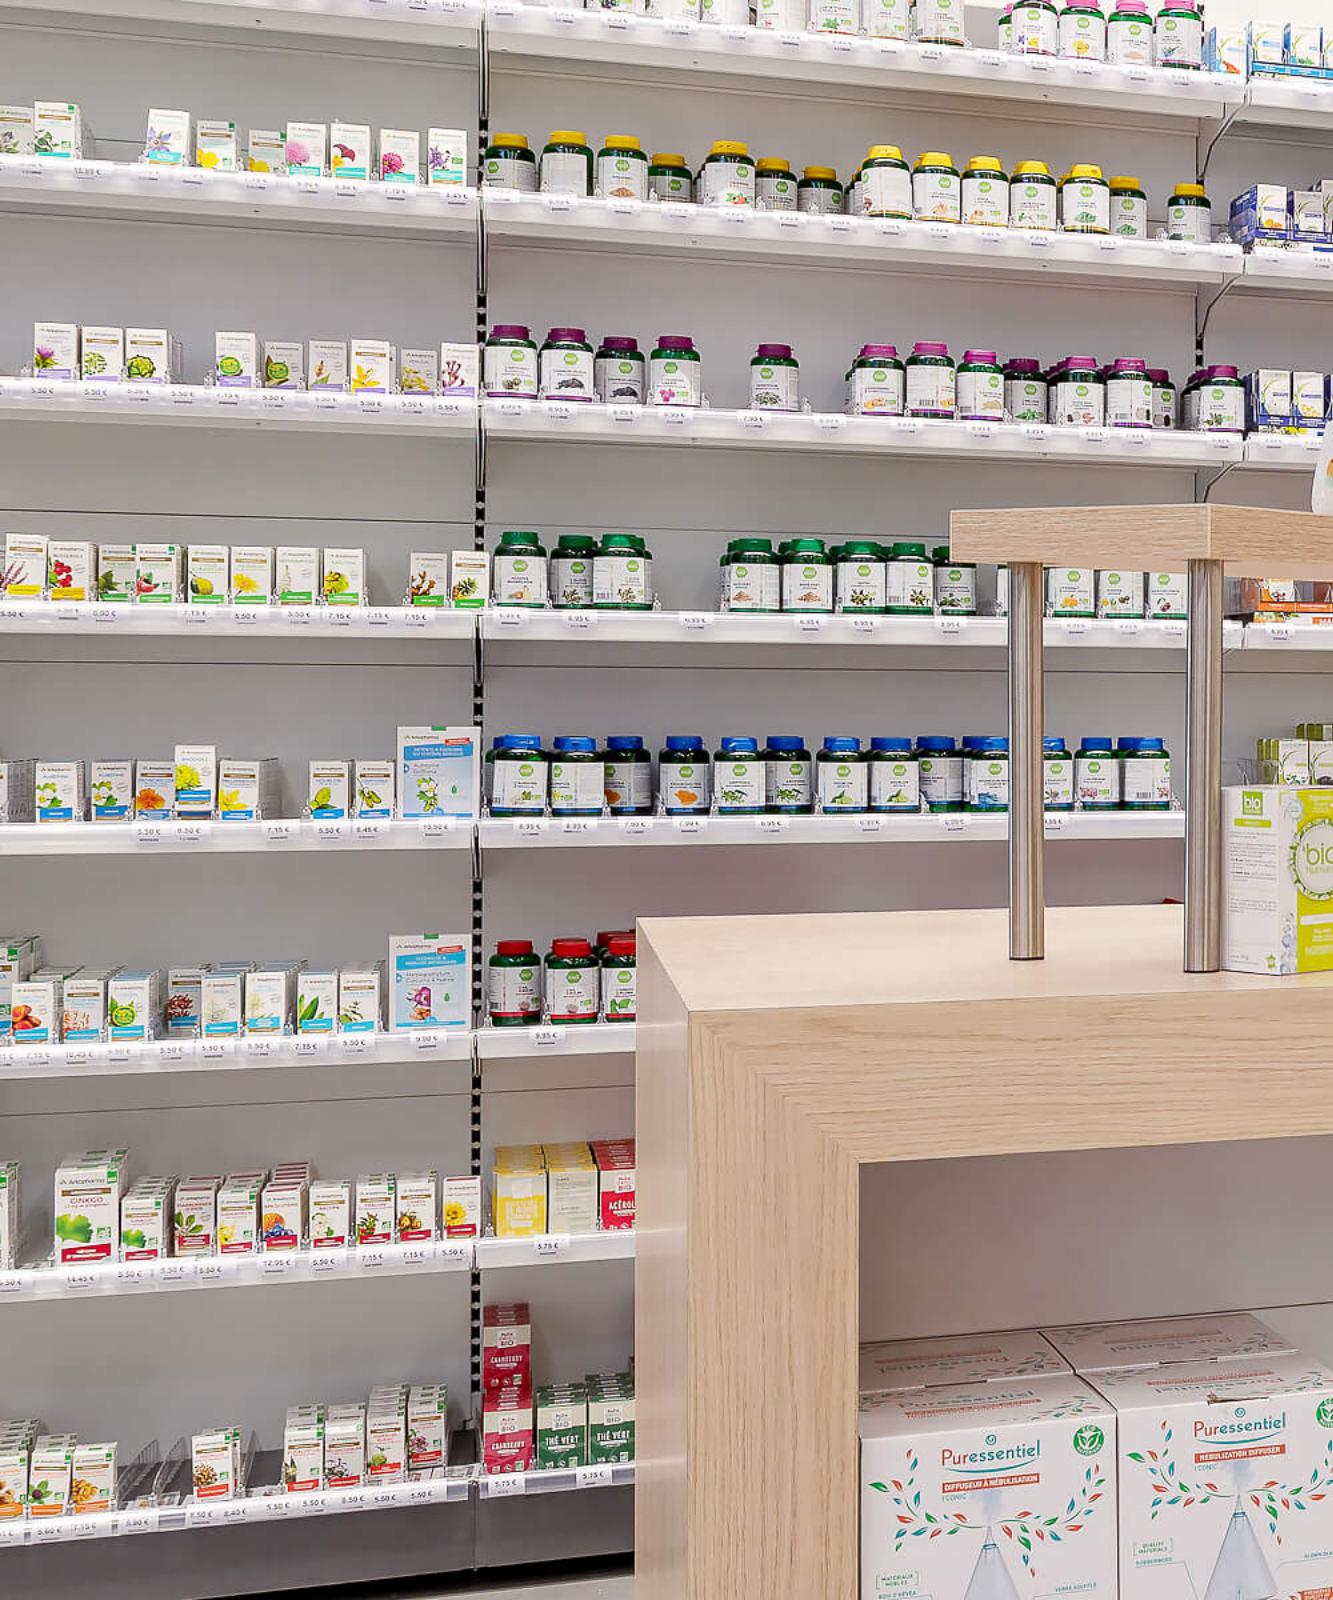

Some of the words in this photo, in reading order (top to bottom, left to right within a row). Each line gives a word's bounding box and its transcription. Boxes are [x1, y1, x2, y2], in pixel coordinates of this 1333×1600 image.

[1243, 793, 1261, 811] bio
[608, 1199, 636, 1211] ACÉROL
[1193, 1411, 1286, 1438] Puressentiel
[545, 1435, 559, 1445] THÉ
[560, 1434, 579, 1445] VERT
[597, 1431, 611, 1441] THÉ
[613, 1430, 630, 1440] VERT
[942, 1440, 1040, 1466] Puressentiel
[1200, 1450, 1247, 1462] NEBULIZATION
[1249, 1446, 1281, 1458] DIFFUSER
[944, 1479, 982, 1492] DIFFUSEUR
[991, 1474, 1039, 1488] NÉBULISATION
